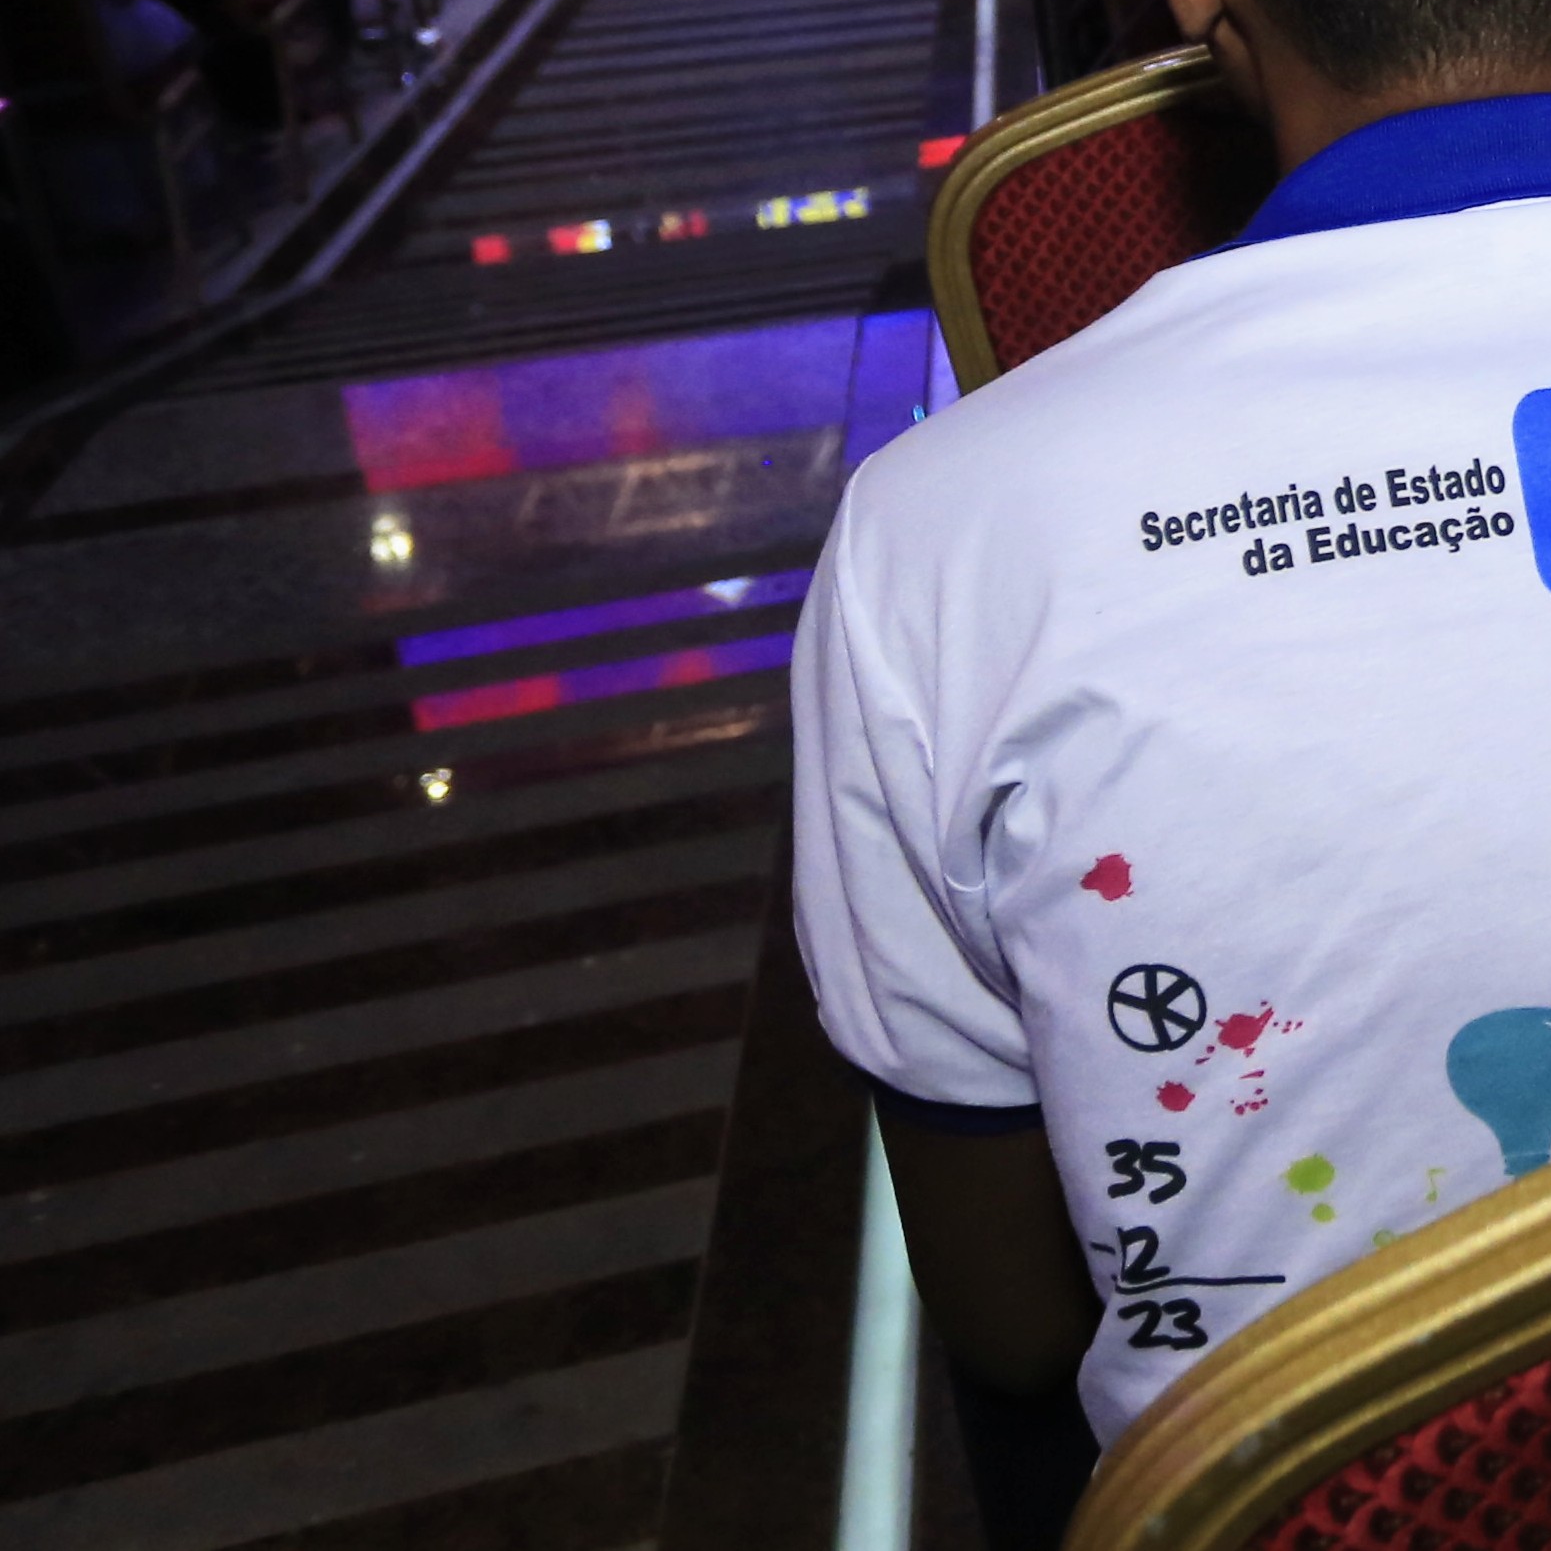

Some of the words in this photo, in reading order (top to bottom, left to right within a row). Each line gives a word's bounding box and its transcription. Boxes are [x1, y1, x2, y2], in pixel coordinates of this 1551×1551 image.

[1140, 483, 1325, 552] Secretaria
[1333, 475, 1377, 515] de
[1385, 457, 1506, 508] Estado
[1242, 538, 1295, 576] da
[1306, 506, 1515, 564] Educação
[1105, 1138, 1187, 1204] 35
[1117, 1298, 1209, 1350] 23
